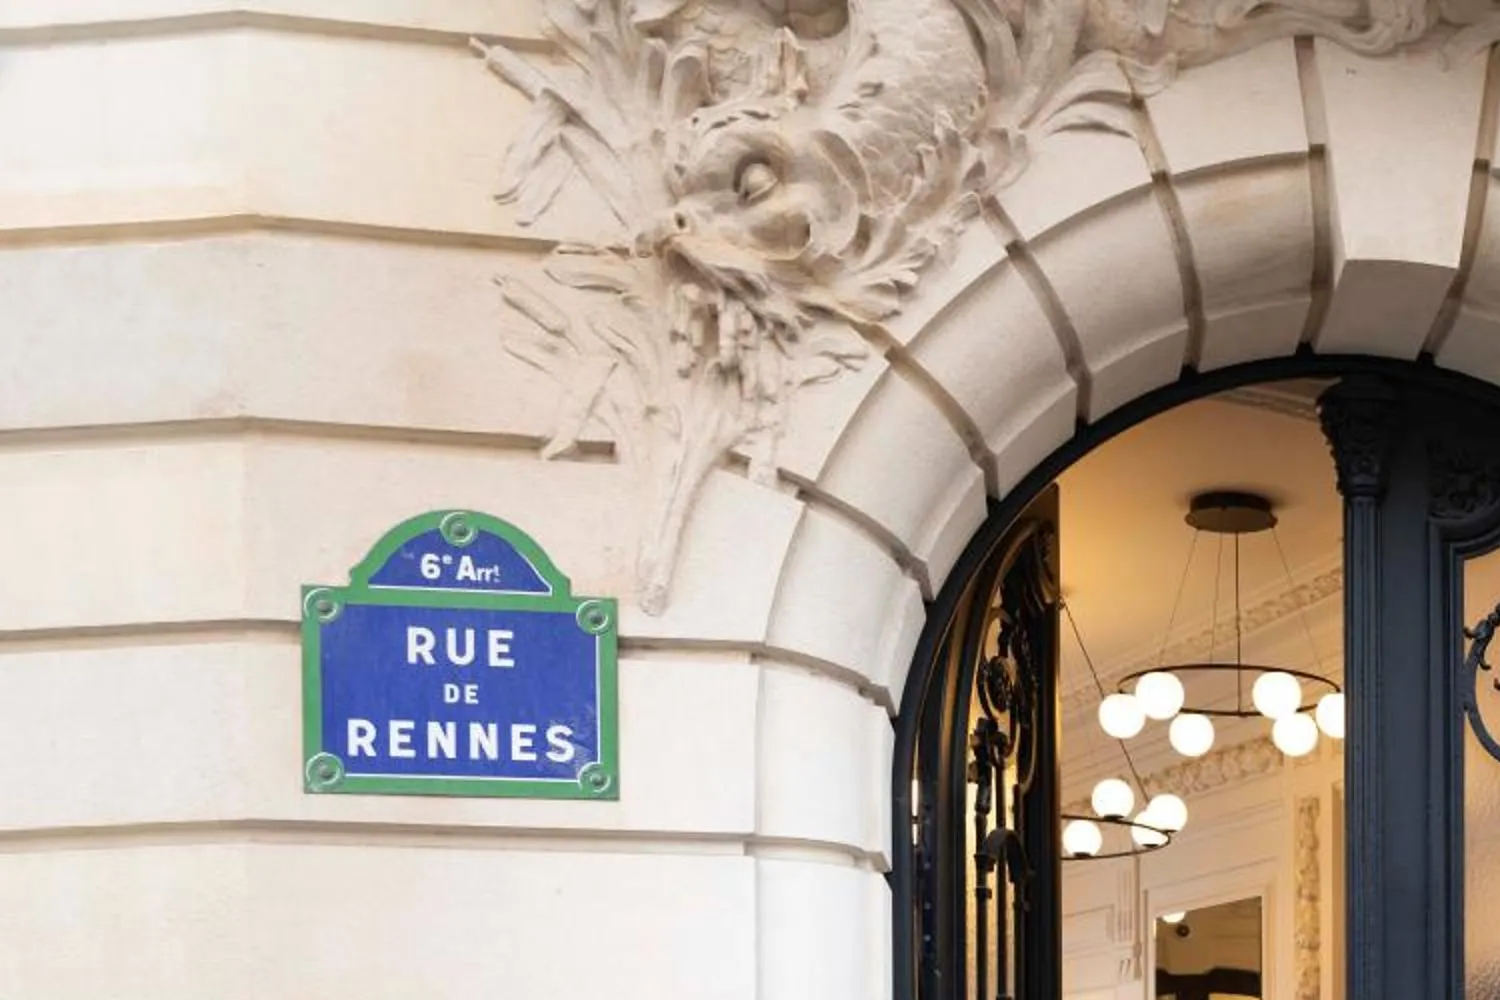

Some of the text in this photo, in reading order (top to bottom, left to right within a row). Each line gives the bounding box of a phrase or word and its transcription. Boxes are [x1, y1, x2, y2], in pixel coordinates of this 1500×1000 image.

[406, 626, 515, 668] RUE
[443, 683, 480, 705] DE
[346, 719, 576, 764] RENNES
